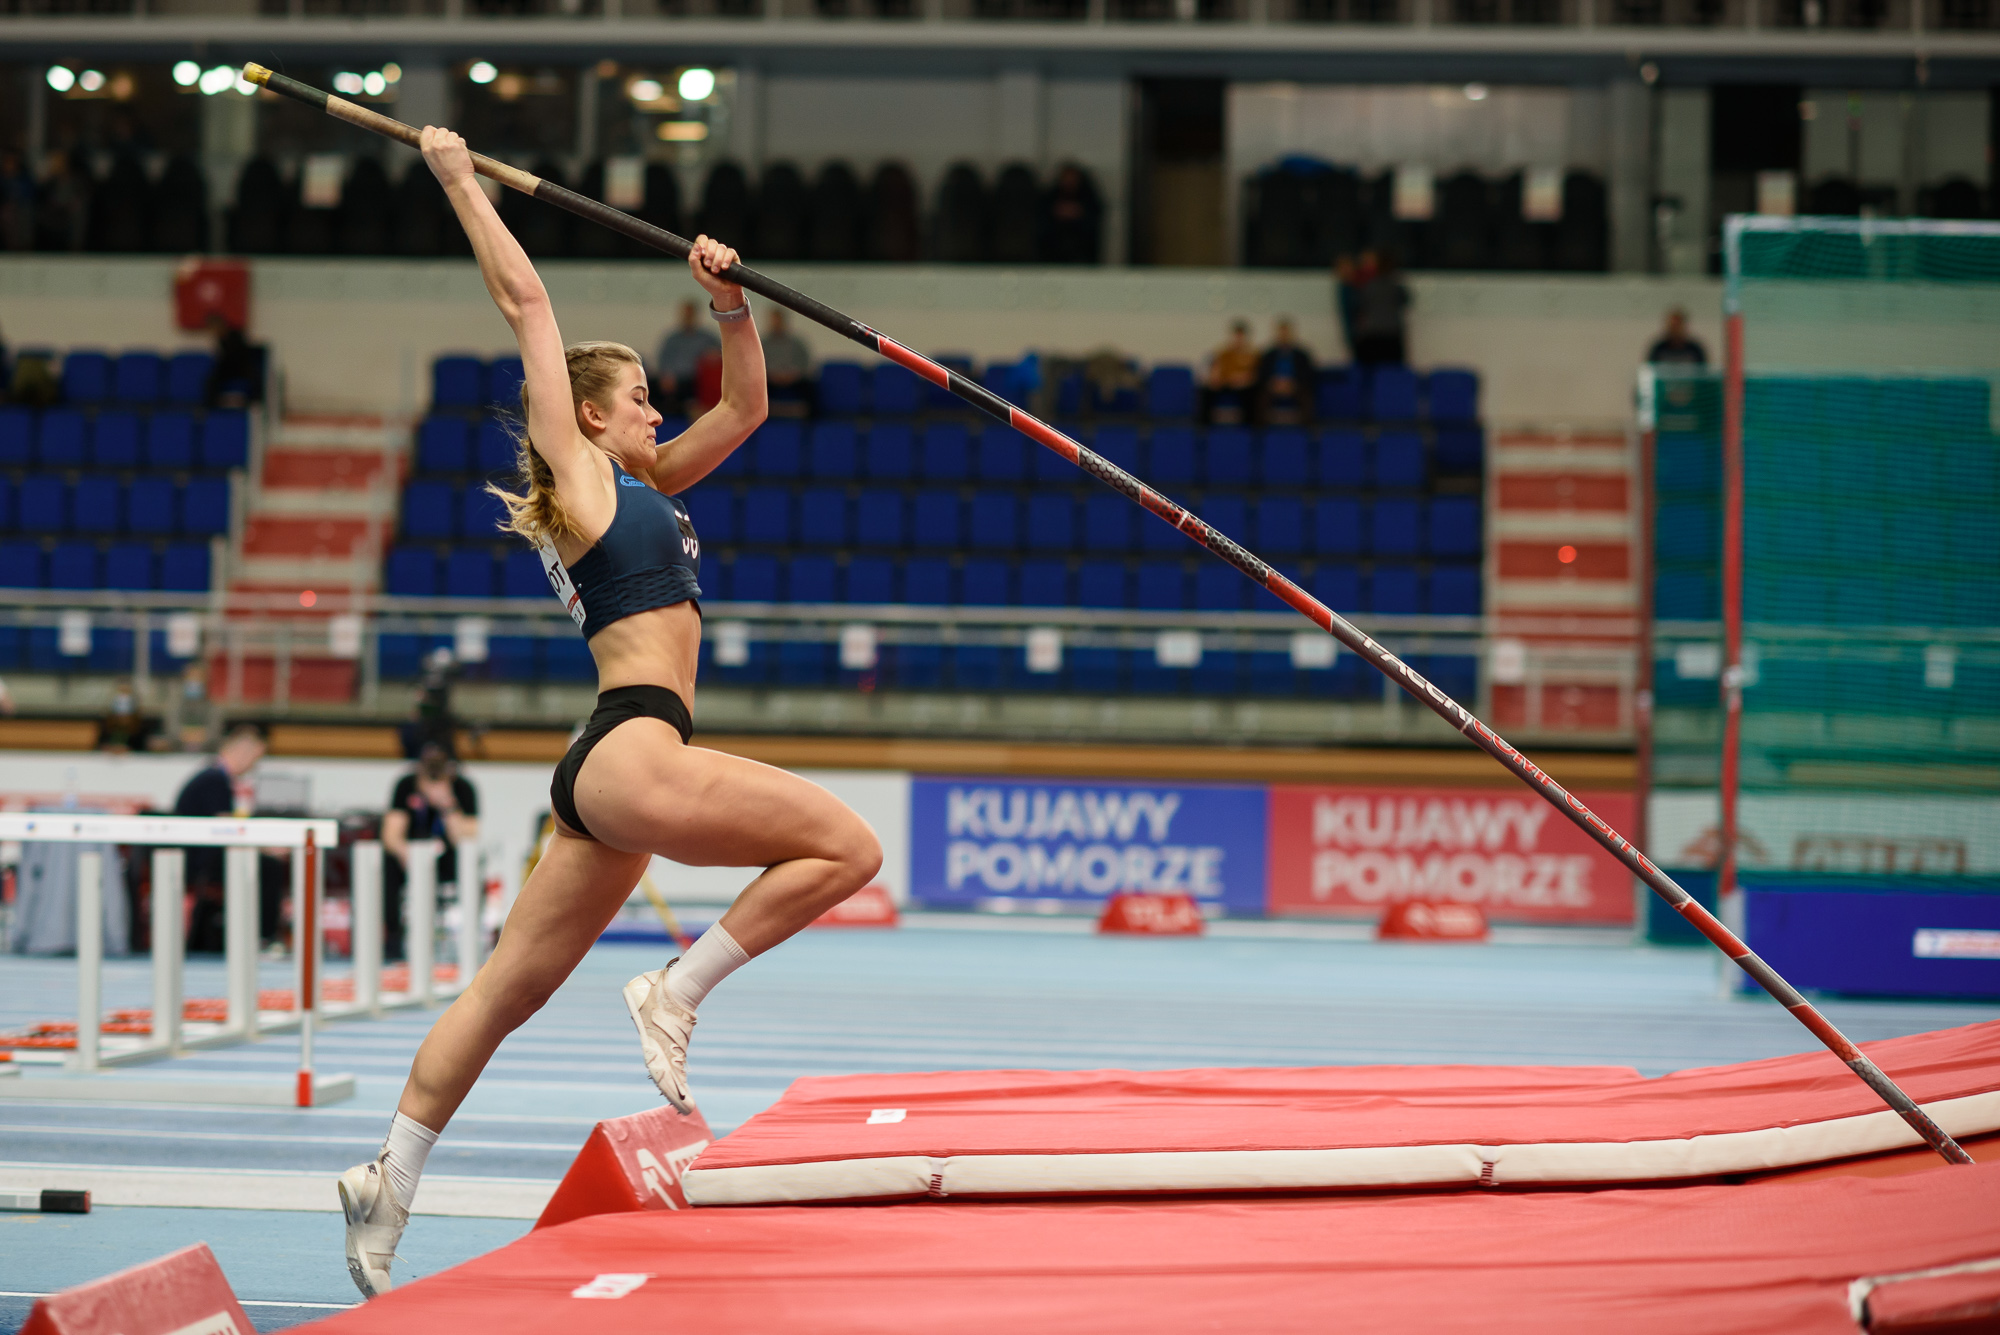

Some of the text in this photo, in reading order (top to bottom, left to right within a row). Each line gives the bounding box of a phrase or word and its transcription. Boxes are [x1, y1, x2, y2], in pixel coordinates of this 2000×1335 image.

[947, 788, 1181, 841] KUJAWY
[1313, 797, 1548, 849] KUJAWY
[947, 840, 1224, 896] POMORZE
[1313, 851, 1593, 907] POMORZE
